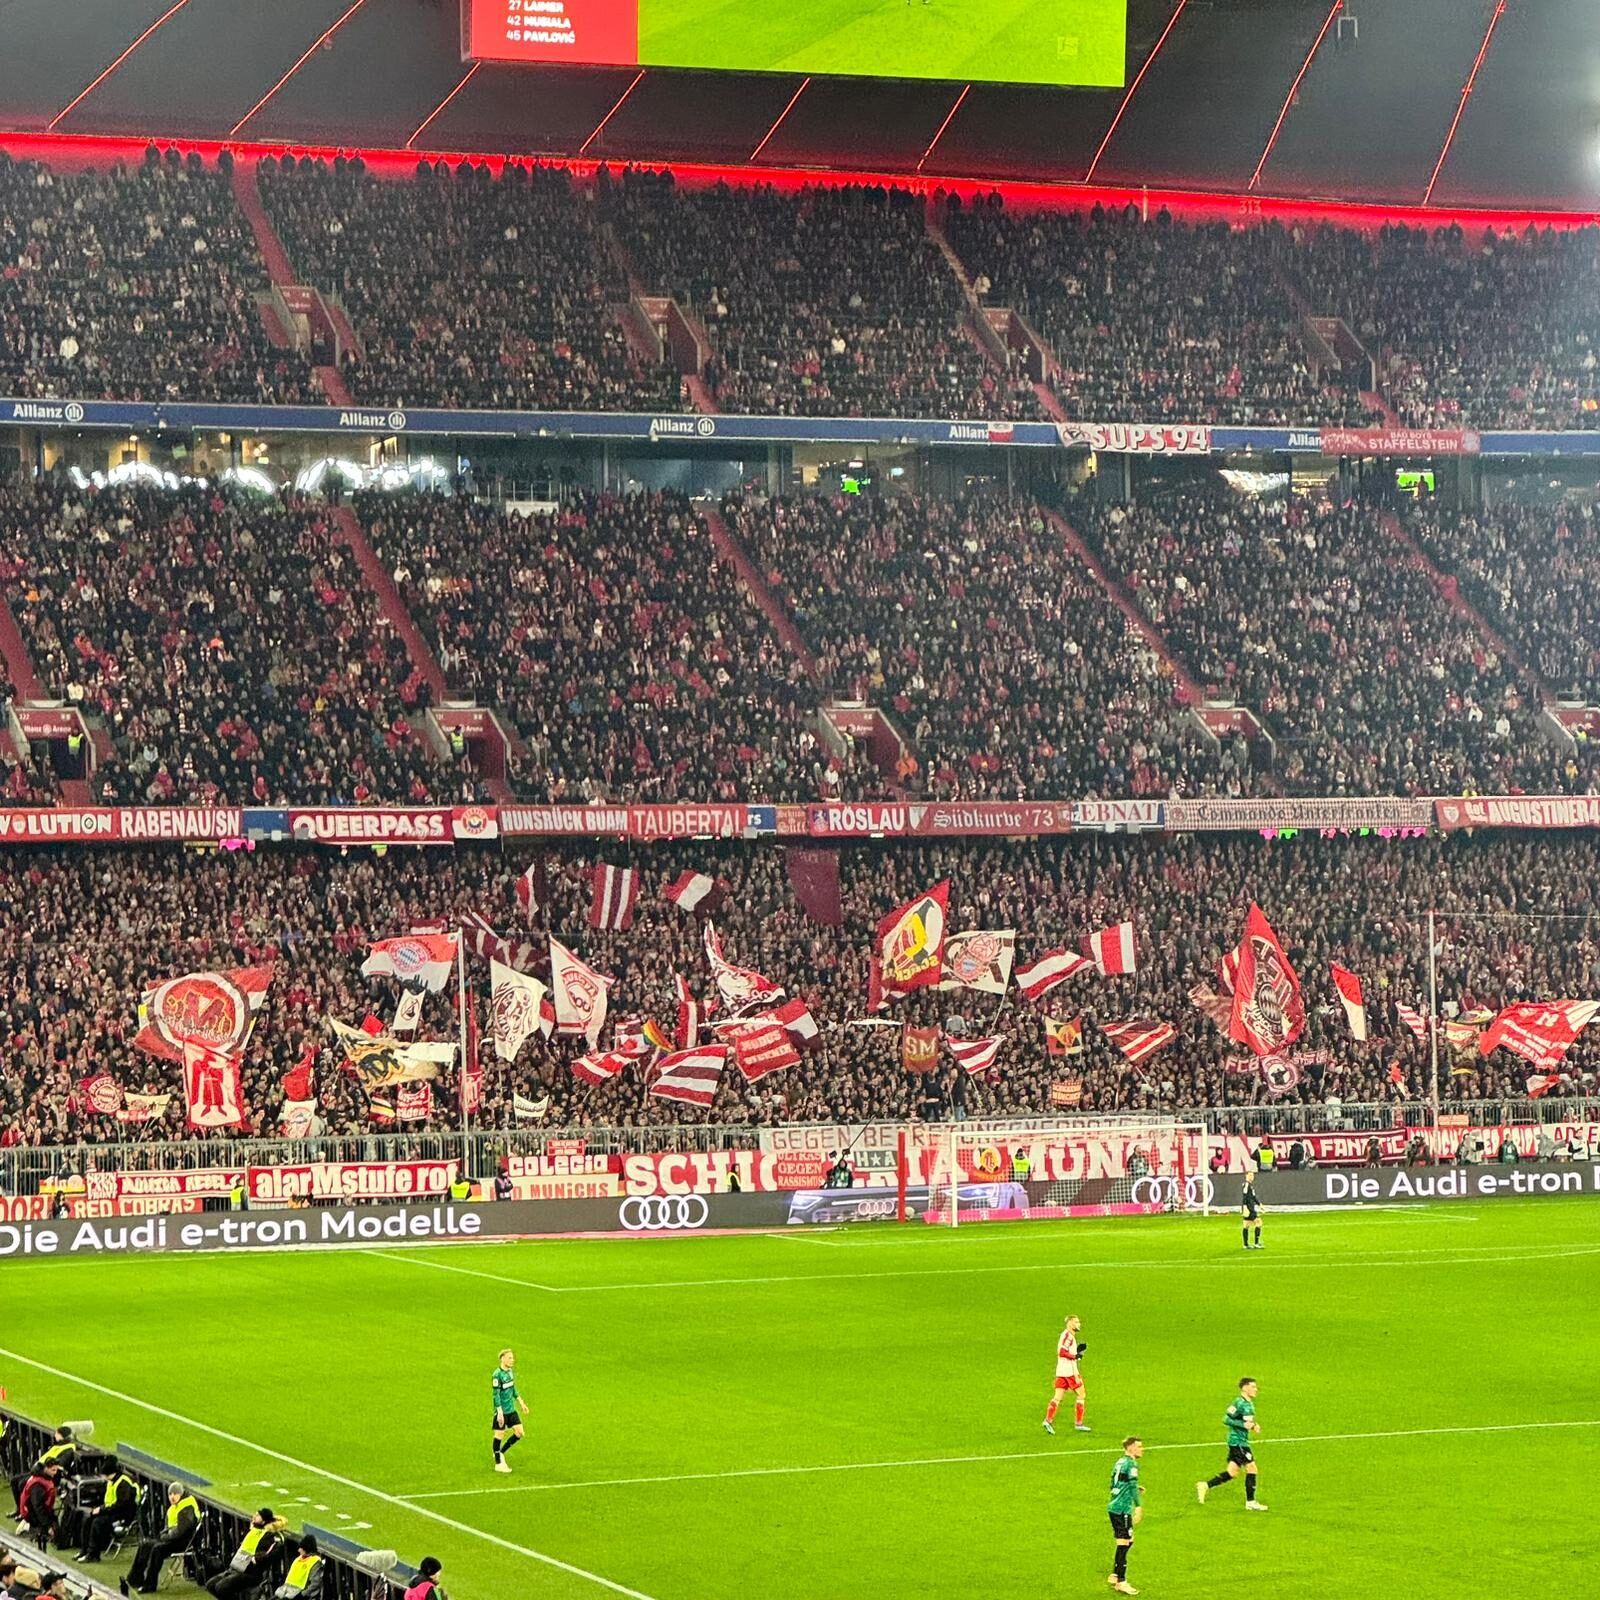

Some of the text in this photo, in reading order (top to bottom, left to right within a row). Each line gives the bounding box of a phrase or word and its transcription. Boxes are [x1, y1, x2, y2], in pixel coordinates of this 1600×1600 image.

[507, 15, 521, 26] 42
[13, 403, 63, 419] Allianz
[339, 411, 386, 427] Allianz
[650, 418, 694, 433] Allianz
[1171, 426, 1211, 451] 94
[1288, 433, 1323, 447] Allian
[1368, 439, 1459, 450] STAFFELSTEIN
[501, 810, 583, 831] HUNSRÜCK
[586, 811, 627, 831] BUAM
[633, 810, 742, 834] TAUBERTAL
[829, 807, 905, 831] RÖSLAU
[933, 809, 1054, 829] Südkurve '73
[1081, 803, 1156, 822] EBNAT
[120, 810, 240, 837] RABENAU/SN
[293, 815, 444, 838] QUEERPASS
[778, 1162, 822, 1174] GEGEN
[1325, 1172, 1380, 1199] Die
[1388, 1169, 1467, 1197] Audi
[1478, 1168, 1582, 1193] e-tron
[74, 1200, 113, 1218] RED
[0, 1207, 481, 1255] Die Audi e-tron Modelle
